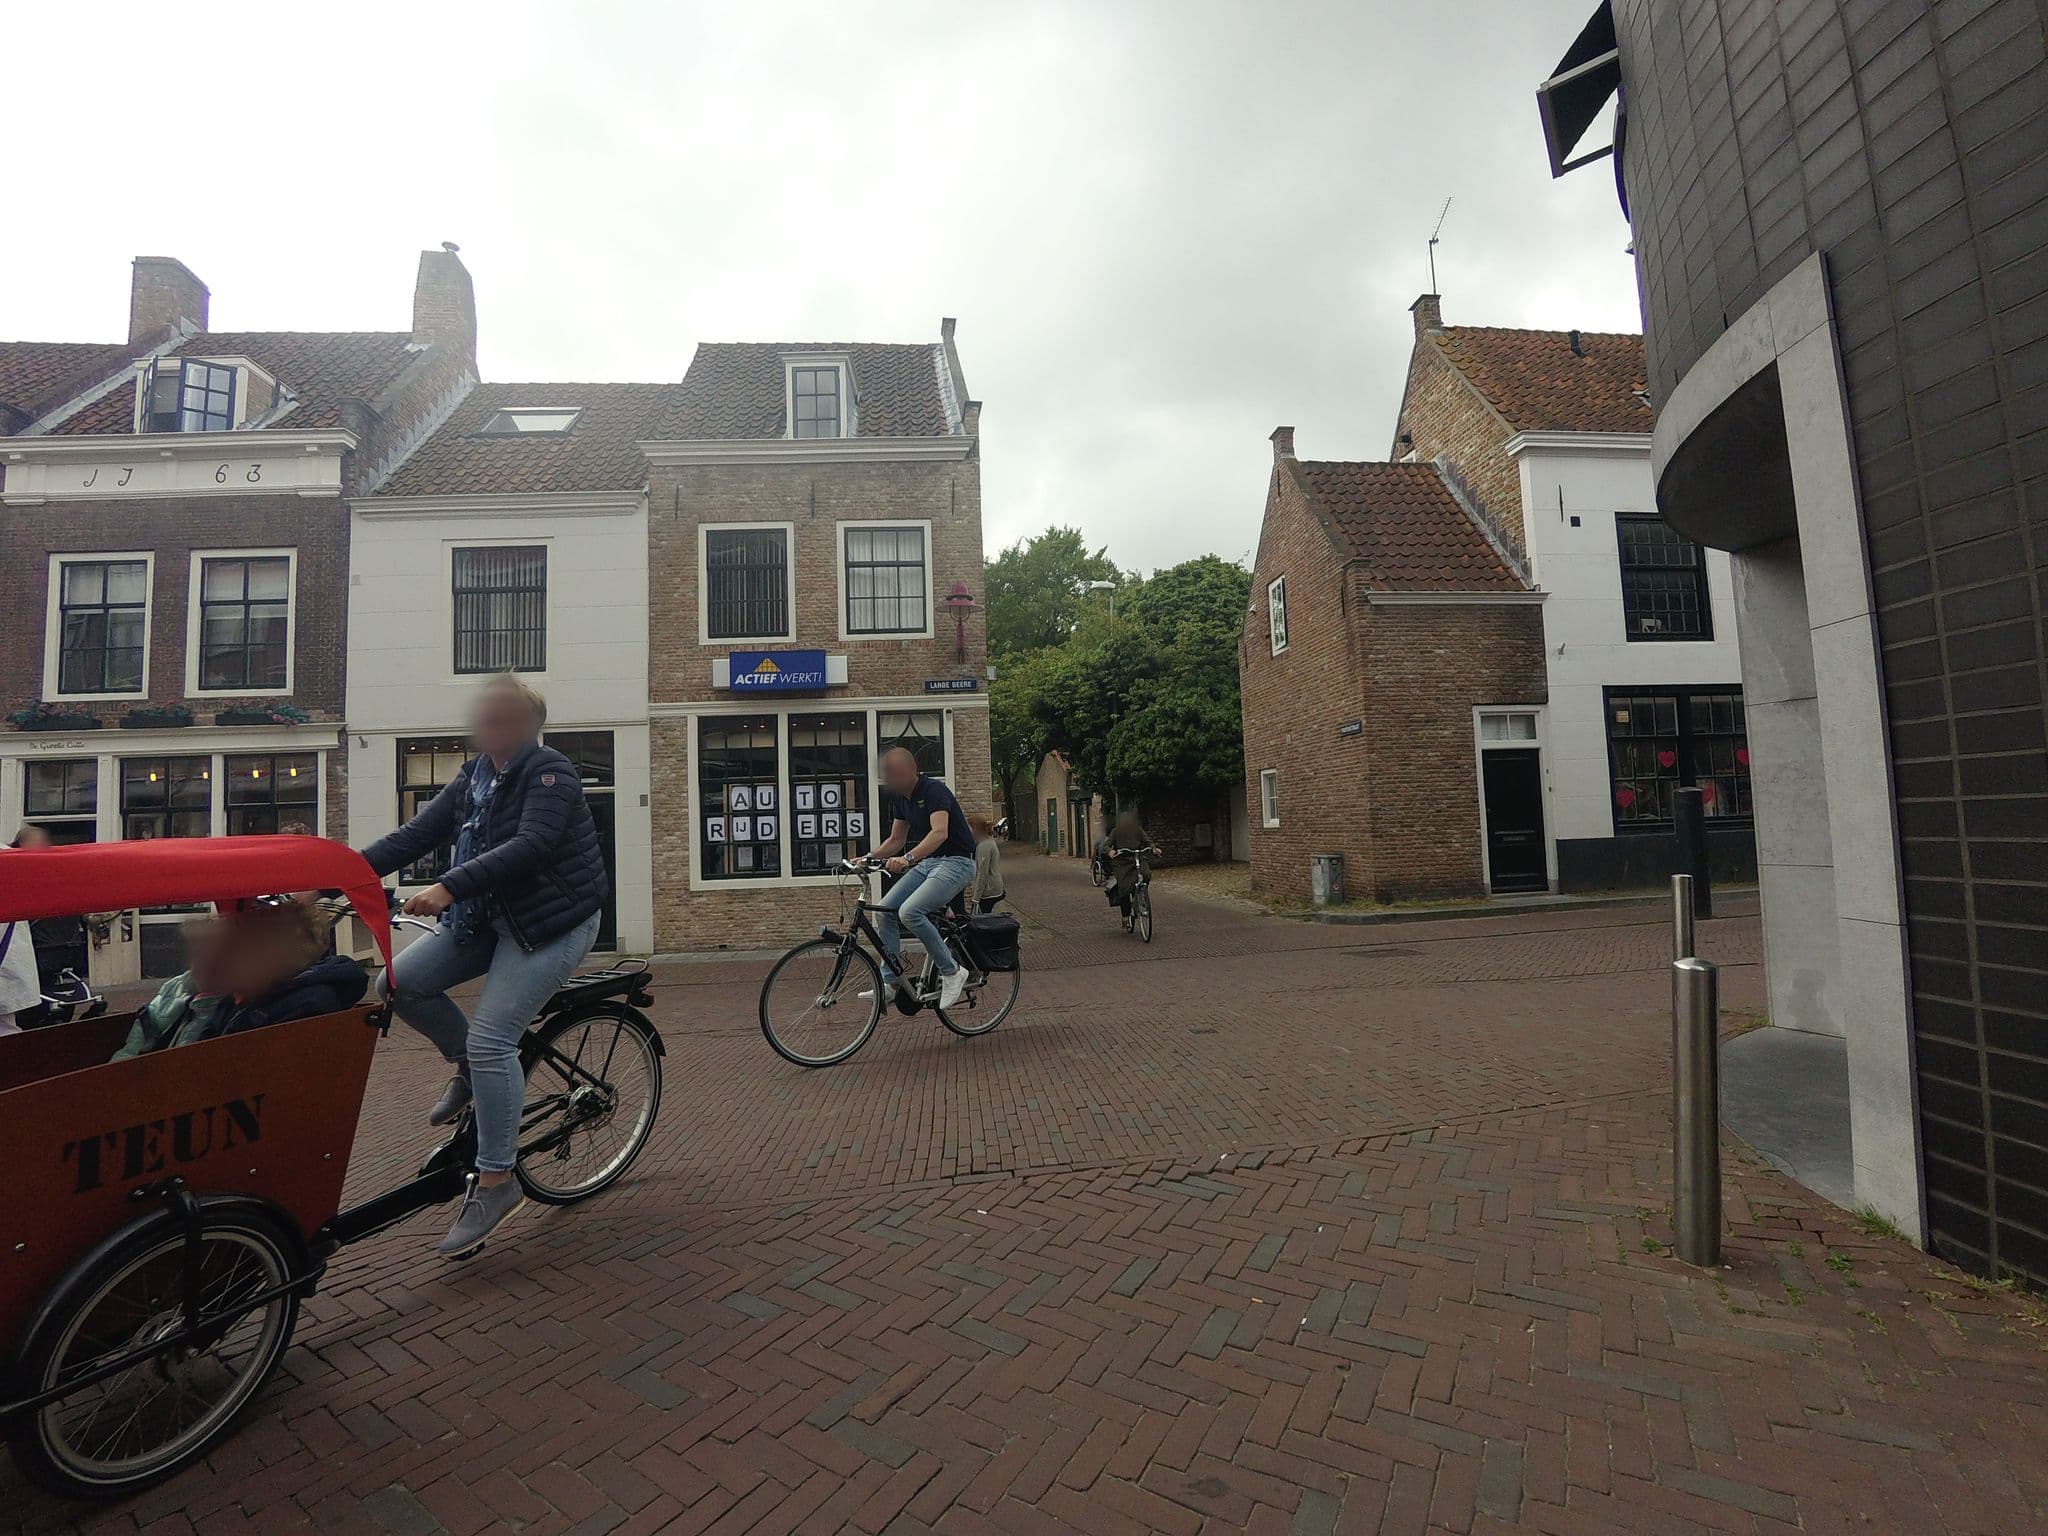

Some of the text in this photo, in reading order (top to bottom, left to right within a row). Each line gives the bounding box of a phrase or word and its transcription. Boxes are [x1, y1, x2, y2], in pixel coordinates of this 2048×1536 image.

[735, 671, 823, 685] ACTIEF WERKT!
[930, 681, 950, 689] LANGE
[734, 790, 839, 808] AUTO
[63, 1092, 266, 1195] TEUN
